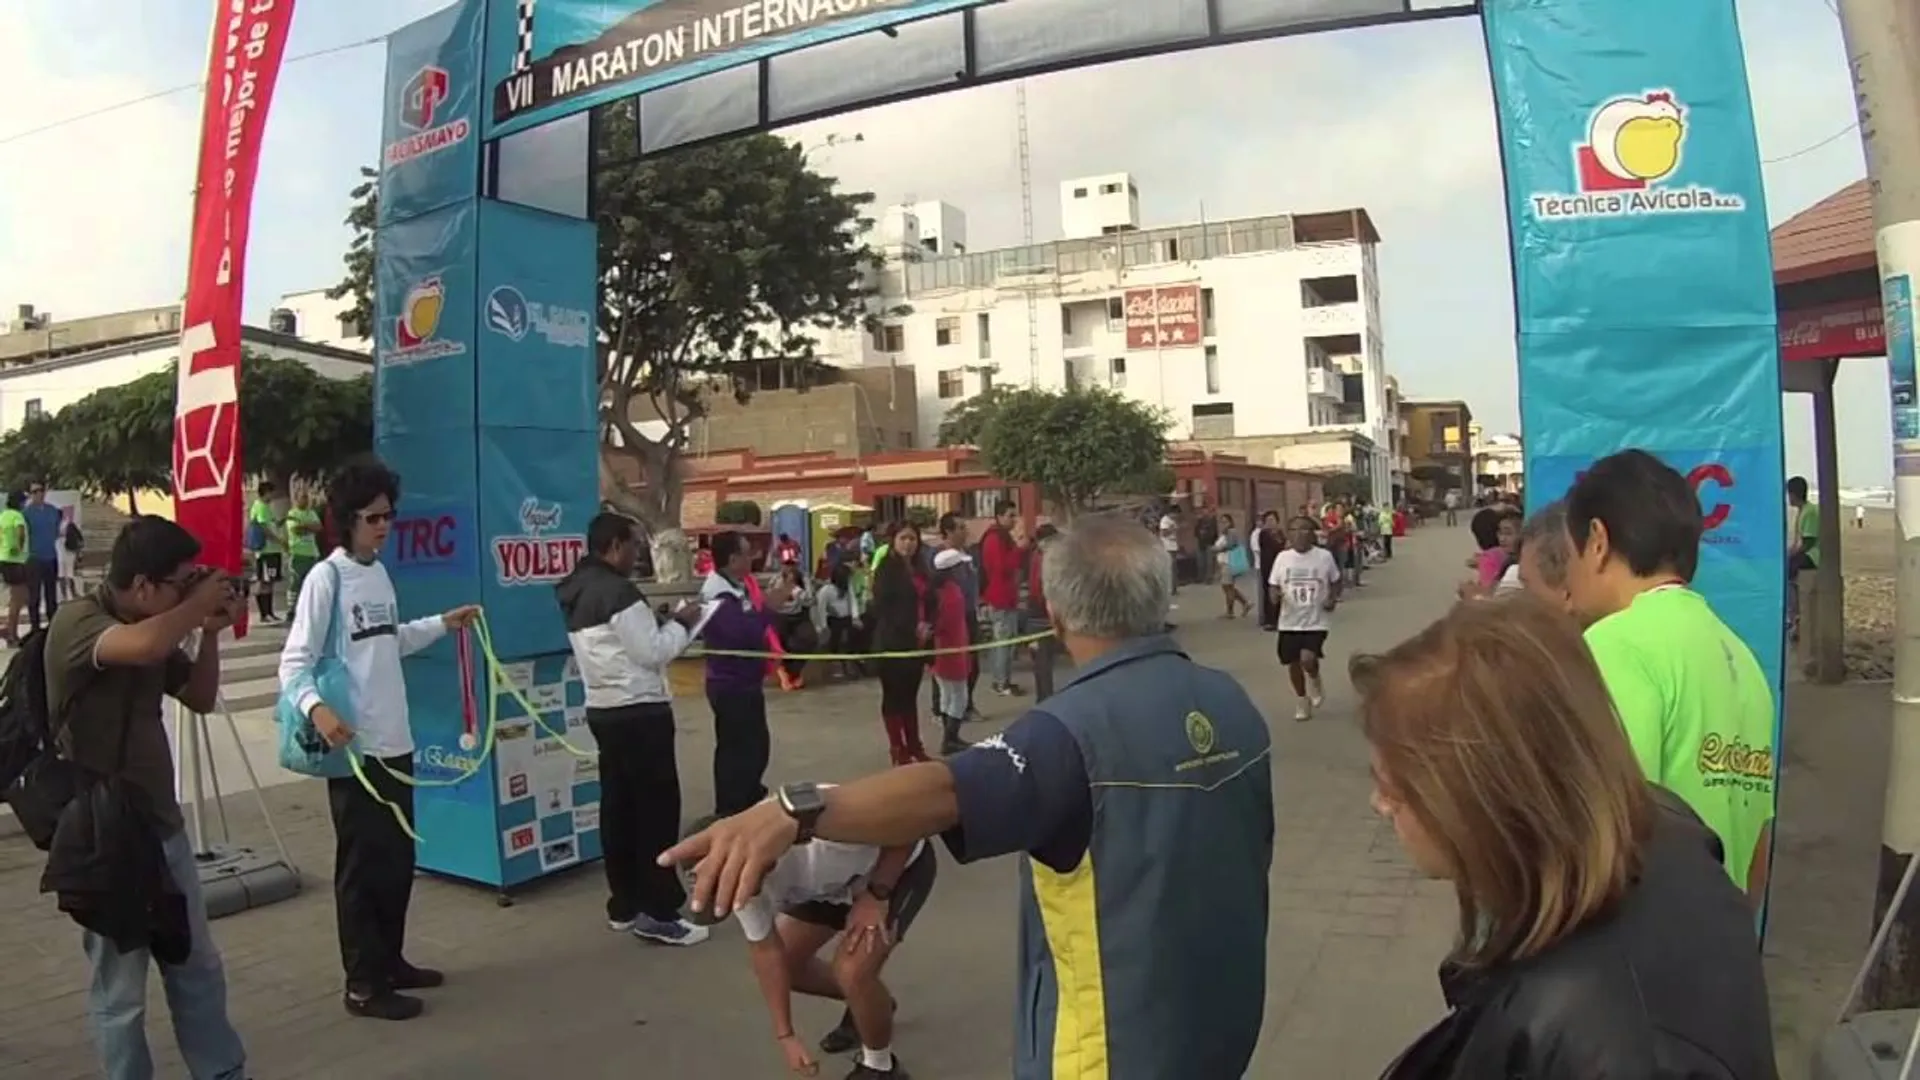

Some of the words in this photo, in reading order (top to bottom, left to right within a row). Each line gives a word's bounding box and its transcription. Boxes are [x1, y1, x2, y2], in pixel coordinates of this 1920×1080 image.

[226, 68, 257, 160] mejor
[243, 20, 270, 60] de
[505, 73, 534, 112] VII
[551, 25, 685, 98] MARATON
[393, 515, 456, 562] TRC
[498, 539, 584, 578] YOLEIT
